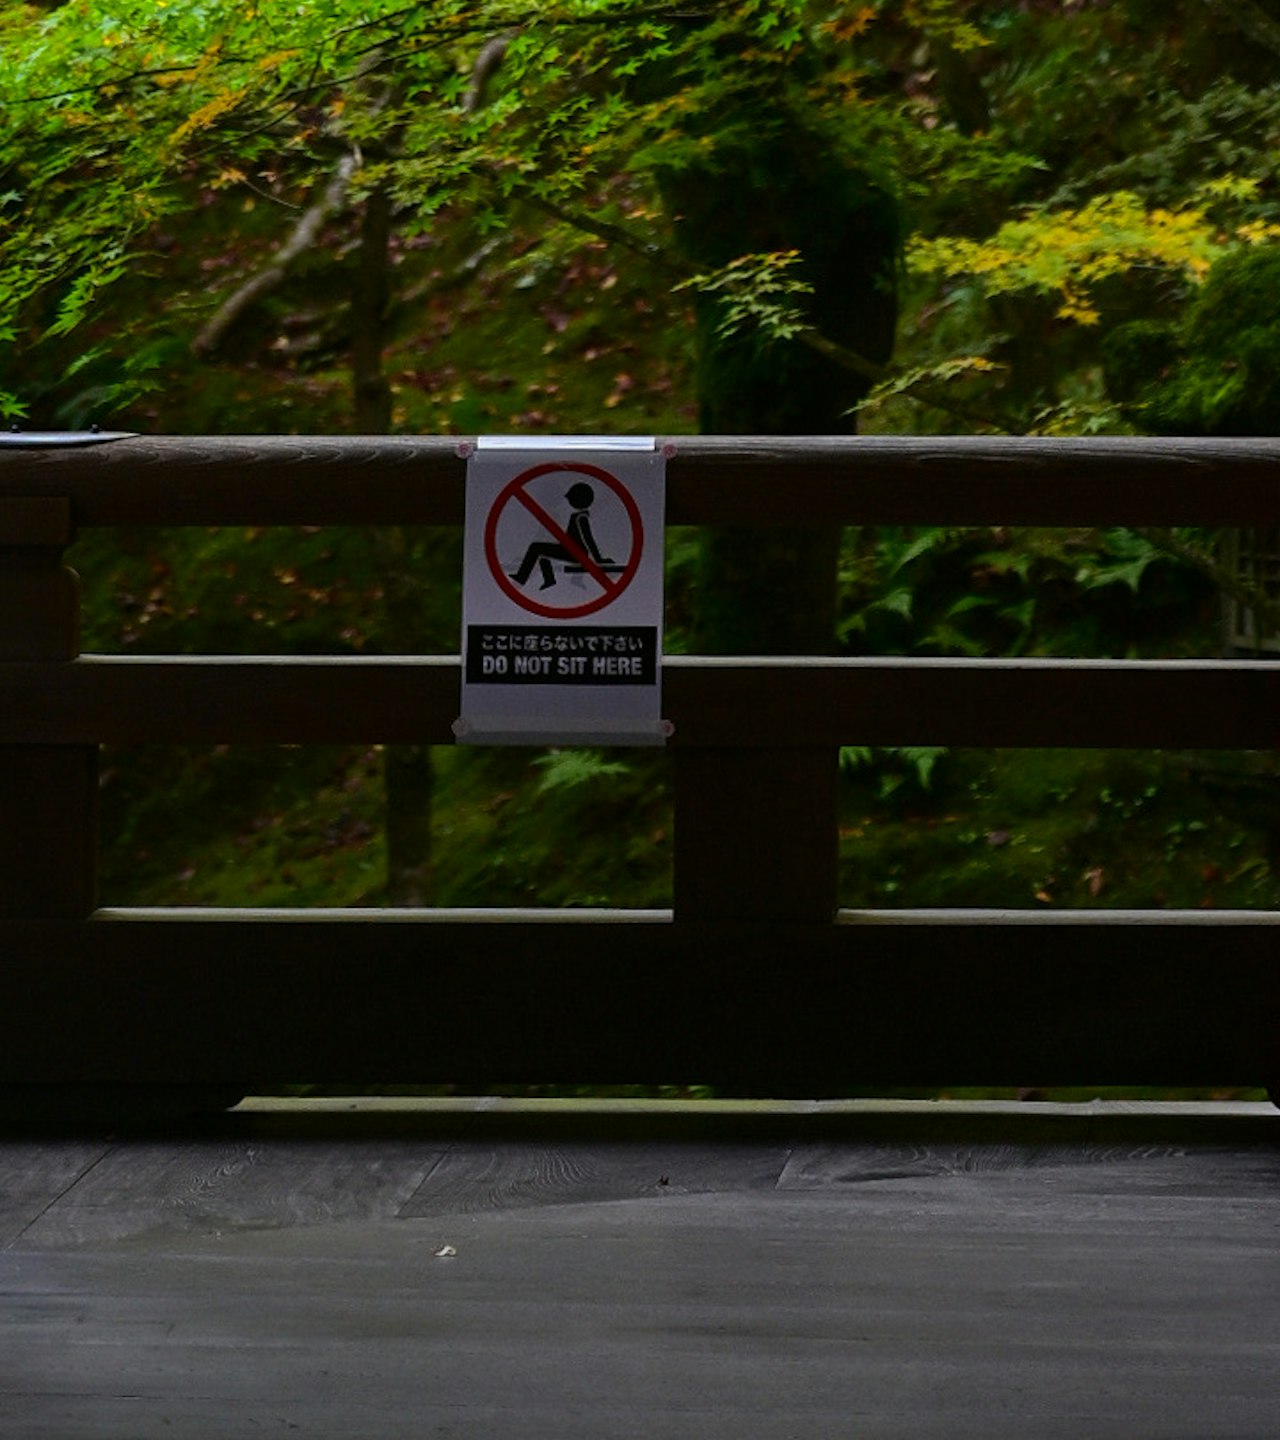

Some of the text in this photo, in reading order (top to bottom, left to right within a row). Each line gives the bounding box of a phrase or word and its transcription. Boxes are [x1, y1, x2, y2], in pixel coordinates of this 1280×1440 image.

[482, 635, 643, 651] ここに座らないで下さい
[483, 656, 643, 675] DO NOT SIT HERE
